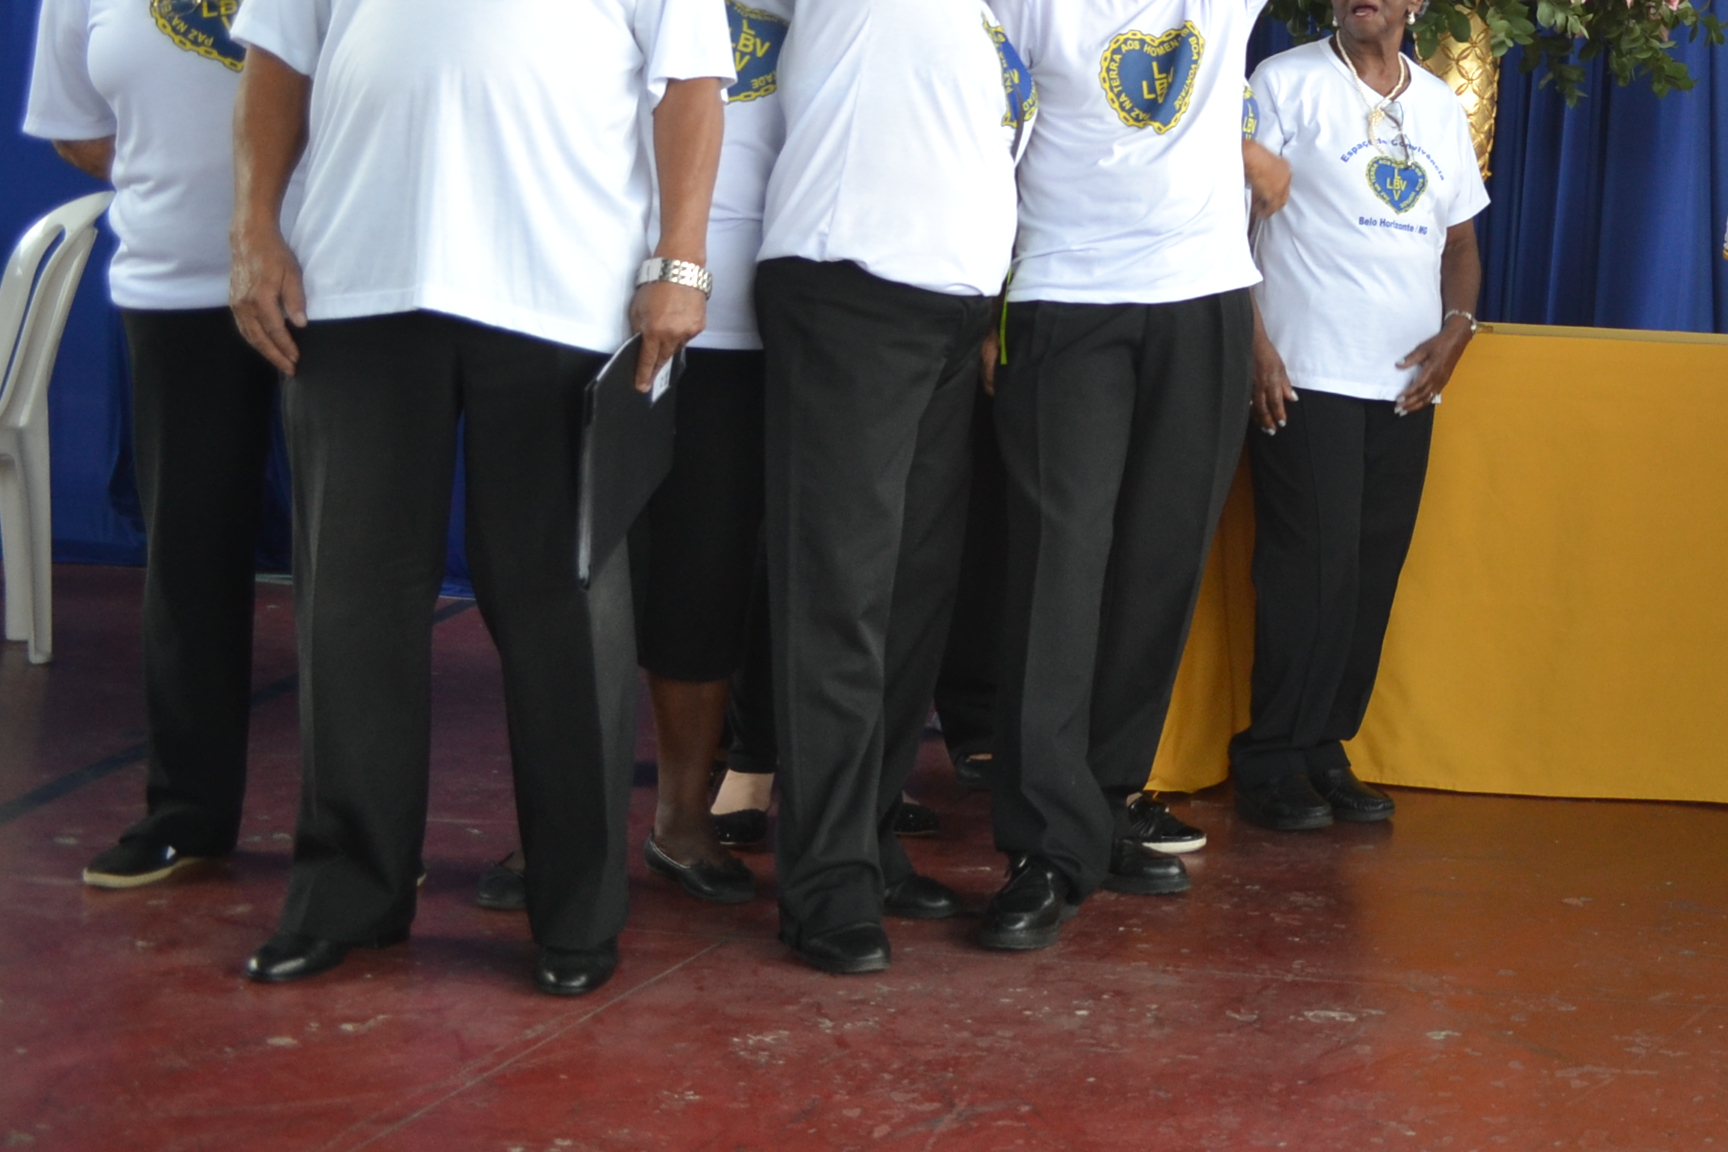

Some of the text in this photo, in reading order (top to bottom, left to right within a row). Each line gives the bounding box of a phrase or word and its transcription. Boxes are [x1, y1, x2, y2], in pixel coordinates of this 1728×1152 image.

[187, 28, 214, 47] PAZ
[731, 32, 770, 57] BV
[1120, 40, 1140, 54] AOS
[1143, 36, 1182, 57] HOMEN
[1109, 54, 1123, 93] TERRA
[1119, 93, 1133, 110] NA
[1358, 216, 1377, 227] Belo
[1379, 217, 1414, 233] Horizonte
